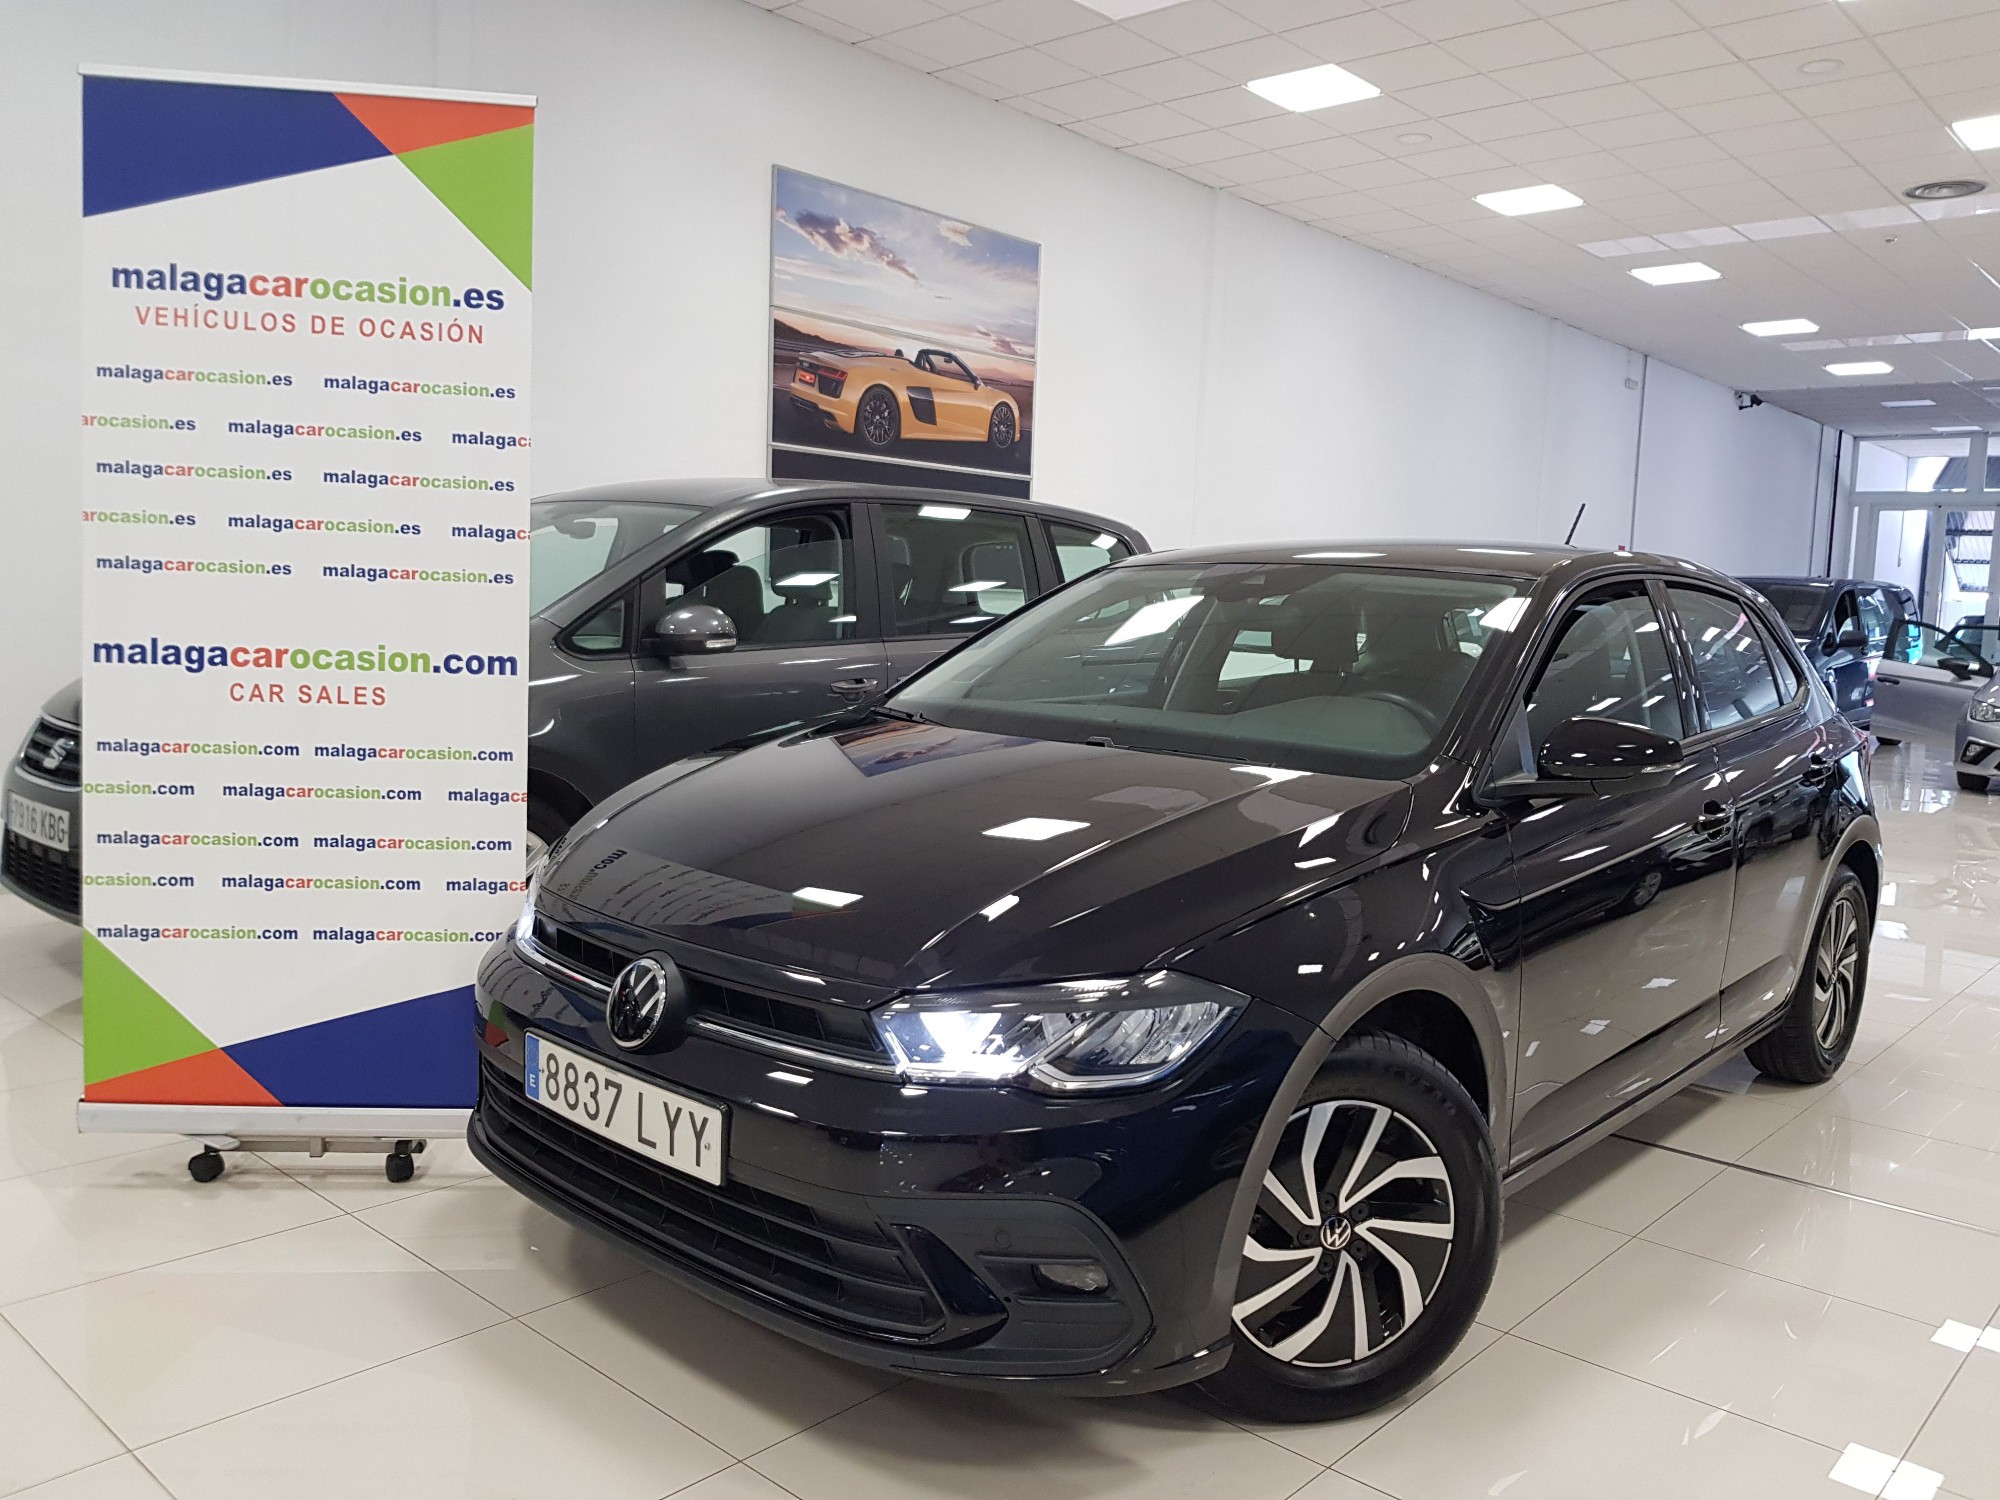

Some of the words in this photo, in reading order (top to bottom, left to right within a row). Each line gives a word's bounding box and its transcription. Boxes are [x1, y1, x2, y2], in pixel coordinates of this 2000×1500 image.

[111, 263, 505, 311] malagacarocasion.es
[135, 304, 296, 334] VEHÍCULOS
[310, 315, 345, 336] DE
[358, 318, 485, 345] OCASIÓN
[96, 364, 293, 387] malagacarocasion.es
[323, 375, 516, 399] malagacarocasion.es
[228, 419, 423, 443] malagacarocasion.es
[452, 431, 532, 450] malagac
[96, 459, 293, 482] malagacarocasion.es
[323, 469, 515, 492] malagacarocasion.es
[227, 513, 422, 536] malagacarocasion.es
[452, 524, 531, 543] malagac
[96, 555, 292, 576] malagacarocasion.es
[323, 563, 514, 586] malagacarocasion.es
[93, 638, 519, 674] malagacarocasion.com
[229, 683, 285, 703] CAR
[298, 684, 387, 706] SALES
[96, 738, 300, 758] malagacarocasion.com
[314, 743, 515, 762] malagacarocasion.com
[222, 782, 423, 802] malagacarocasion.com
[40, 809, 66, 843] KBG
[96, 830, 300, 849] malagacarocasion.com
[313, 834, 513, 853] malagacarocasion.com
[221, 873, 422, 893] malagacarocasion.com
[96, 924, 299, 943] malagacarocasion.com
[529, 1073, 537, 1089] E
[545, 1053, 623, 1129] 8837
[637, 1091, 709, 1168] LYY
